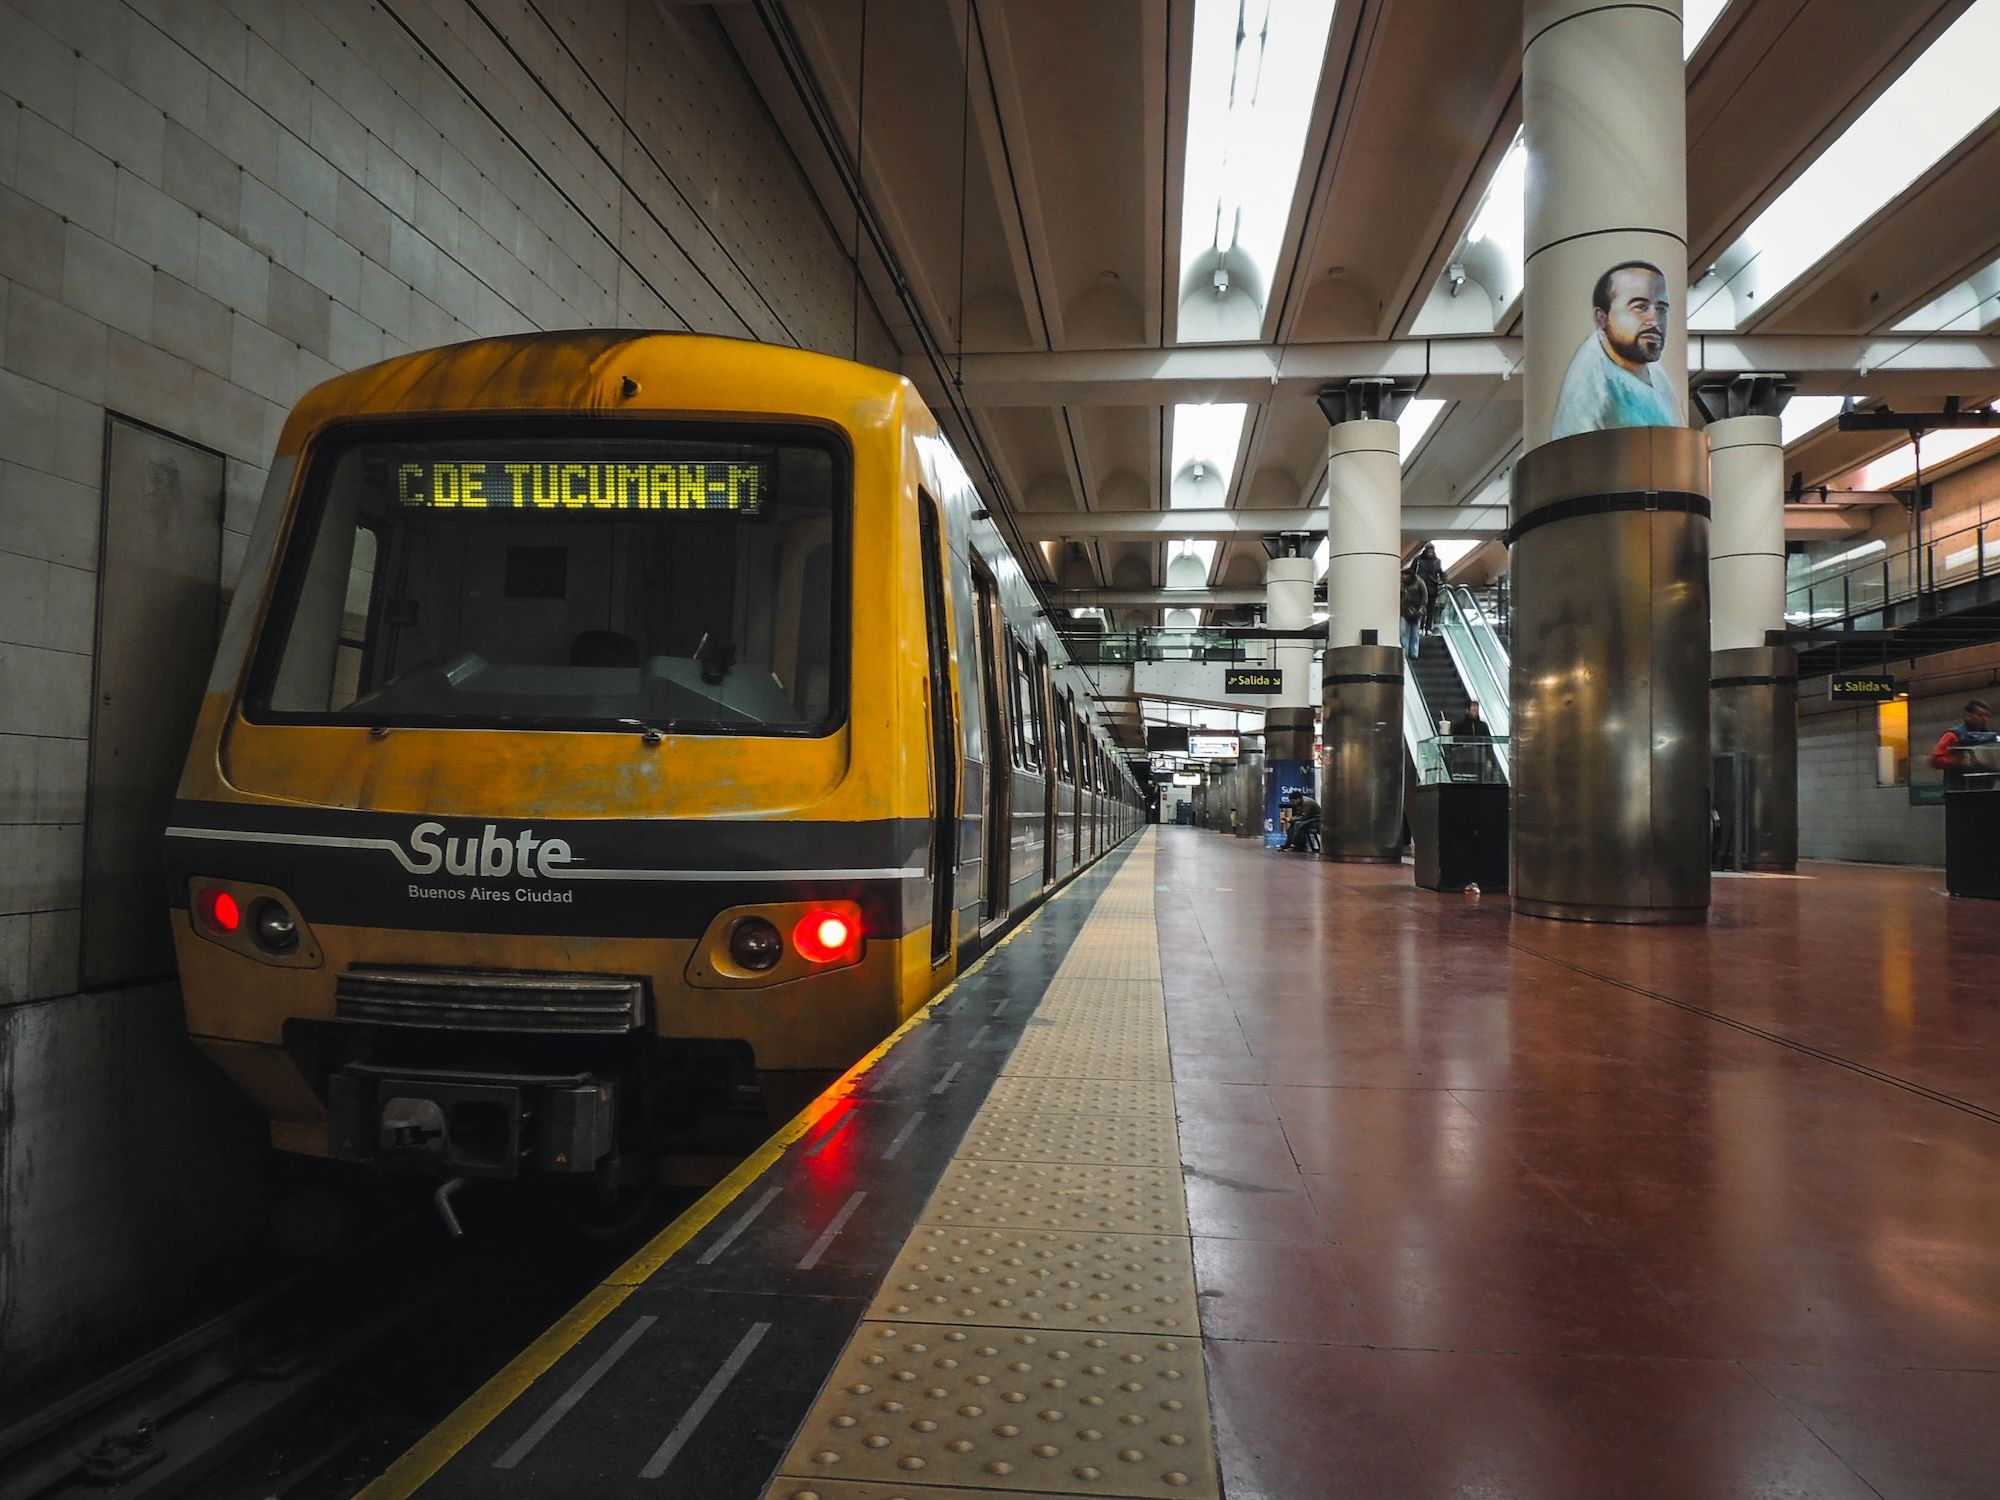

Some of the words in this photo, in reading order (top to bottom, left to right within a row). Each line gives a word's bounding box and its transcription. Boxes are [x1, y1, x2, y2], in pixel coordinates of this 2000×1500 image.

[504, 464, 758, 509] TUCUMAN-M
[1238, 675, 1270, 686] Salida
[1845, 681, 1880, 692] Salida
[410, 821, 572, 879] Subte
[408, 885, 466, 900] Buenos
[470, 887, 511, 902] Aires
[515, 888, 573, 903] Ciudad
